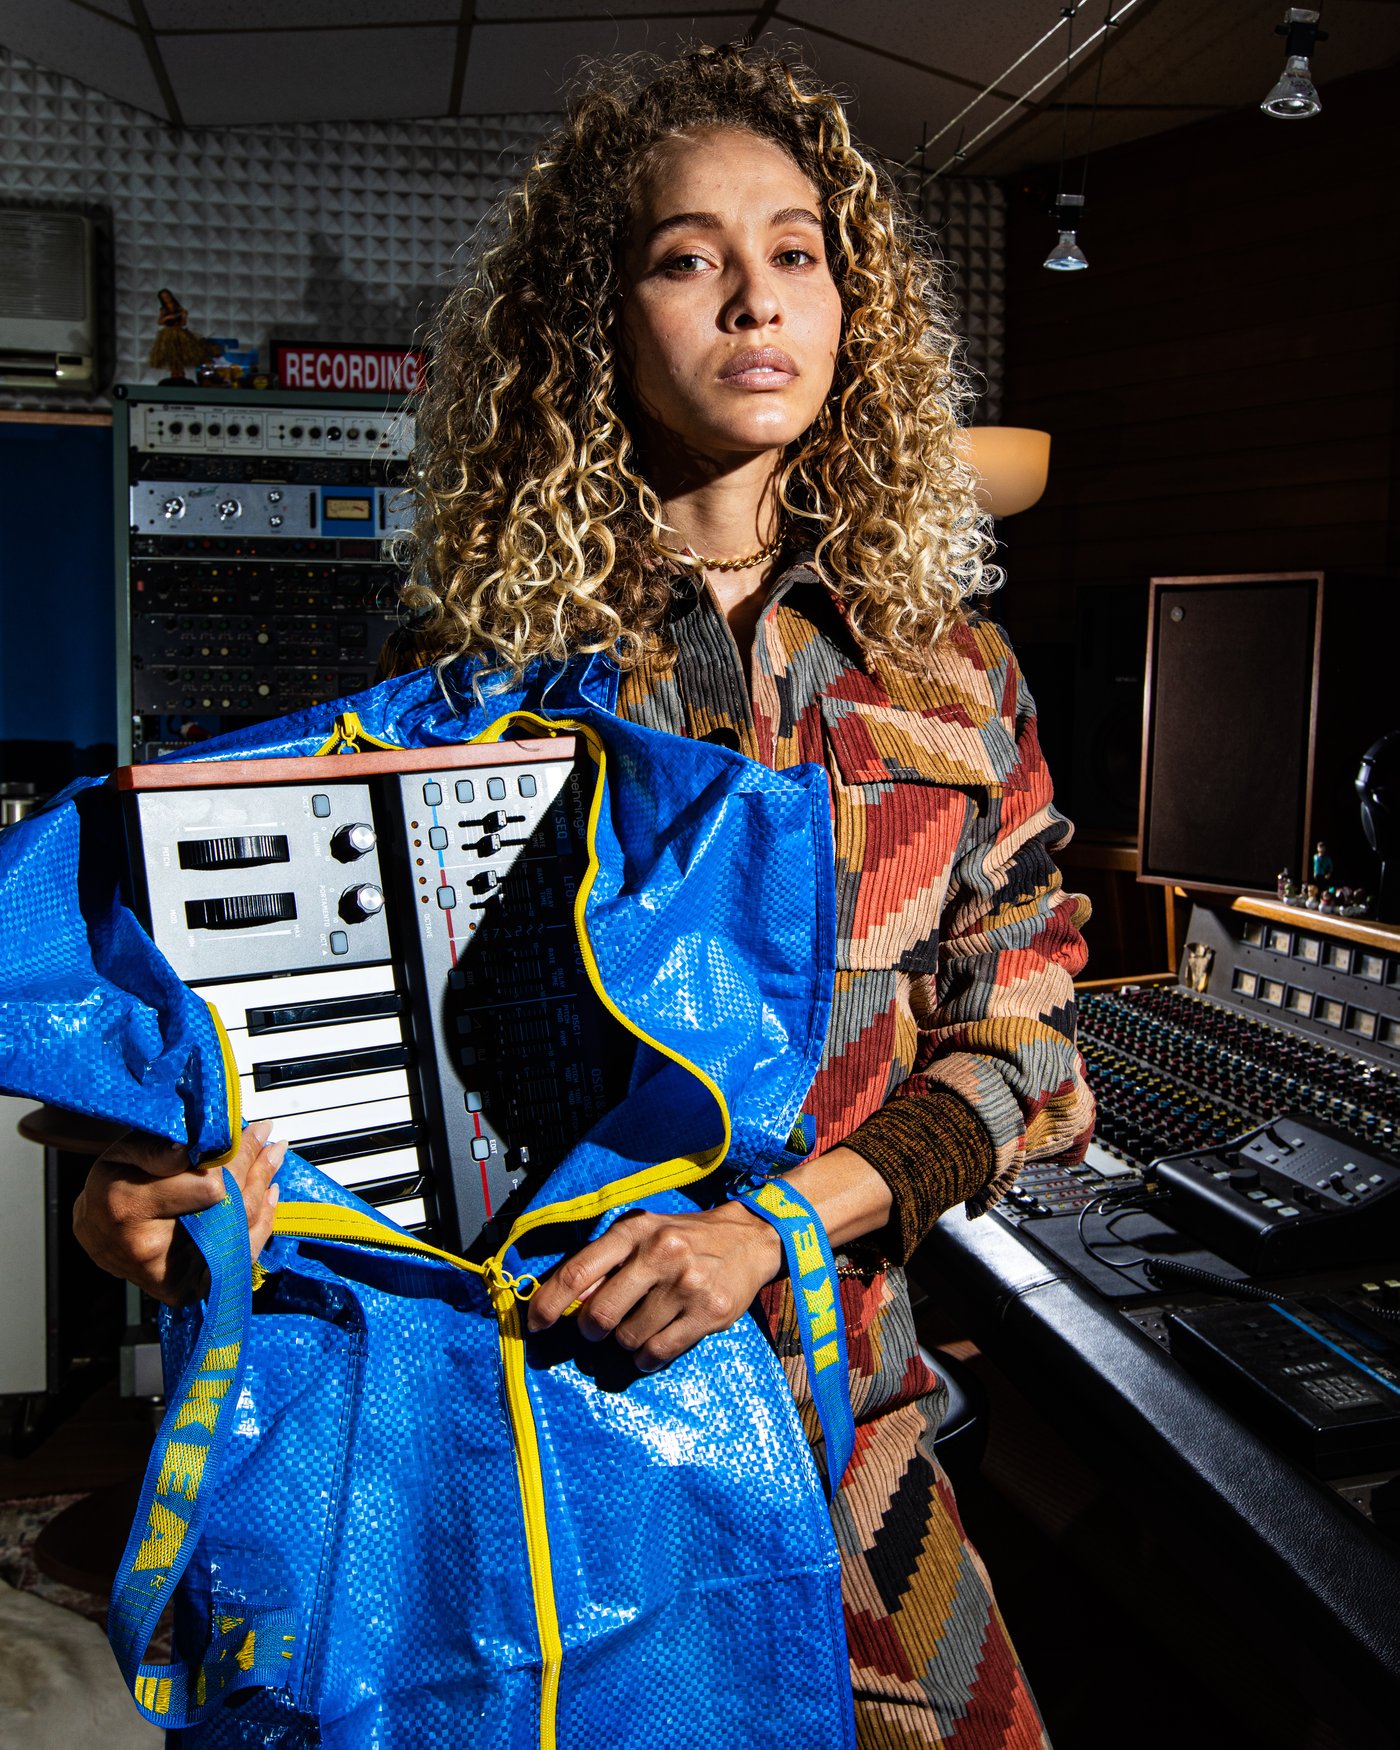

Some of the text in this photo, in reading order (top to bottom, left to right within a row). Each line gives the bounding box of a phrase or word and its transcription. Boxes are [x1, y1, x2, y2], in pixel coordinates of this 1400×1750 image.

[285, 352, 417, 391] RECORDING
[566, 773, 588, 840] behringer
[553, 816, 567, 839] SEQ
[161, 845, 170, 866] PITCH
[562, 874, 576, 898] LFO
[169, 908, 177, 924] MOD
[318, 884, 330, 927] PORTAMENTO
[292, 923, 300, 938] MAX
[423, 912, 433, 938] OCTAVE
[319, 933, 327, 947] OCT
[590, 1067, 603, 1092] OSC
[488, 1139, 497, 1154] EDIT
[755, 1182, 841, 1374] IKEA
[131, 1340, 242, 1572] IKEA
